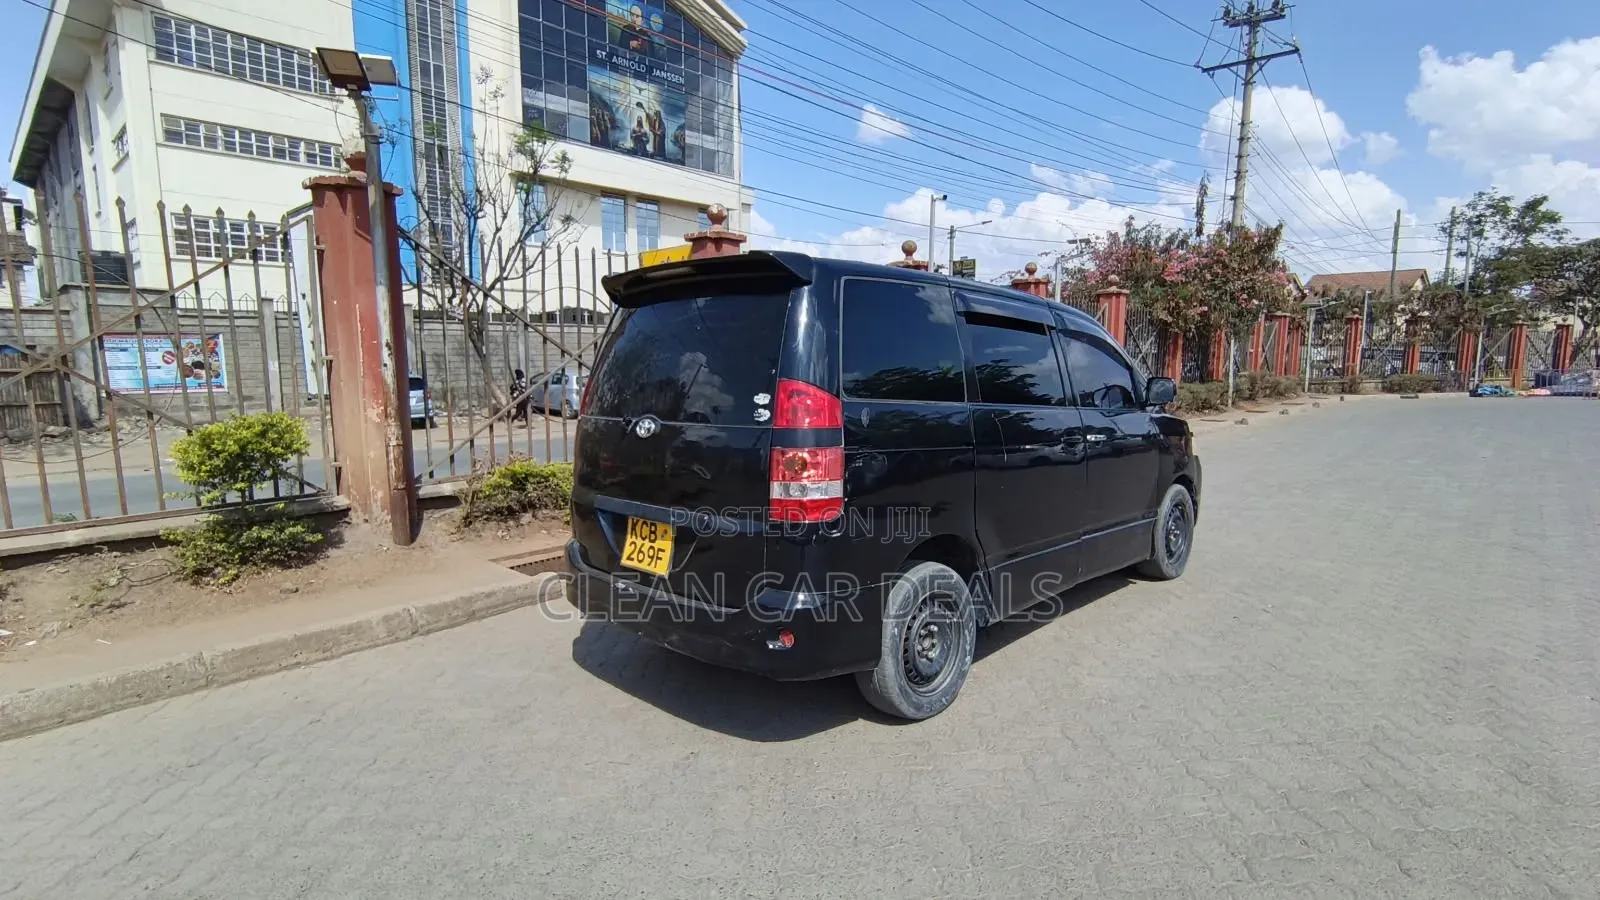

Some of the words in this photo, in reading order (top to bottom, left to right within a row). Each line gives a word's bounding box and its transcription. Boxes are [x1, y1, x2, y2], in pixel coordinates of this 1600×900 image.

[596, 49, 608, 60] ST.
[612, 55, 646, 72] ARNOLD
[652, 68, 685, 85] JANSSEN
[630, 517, 657, 543] KCB
[626, 541, 665, 568] 269F
